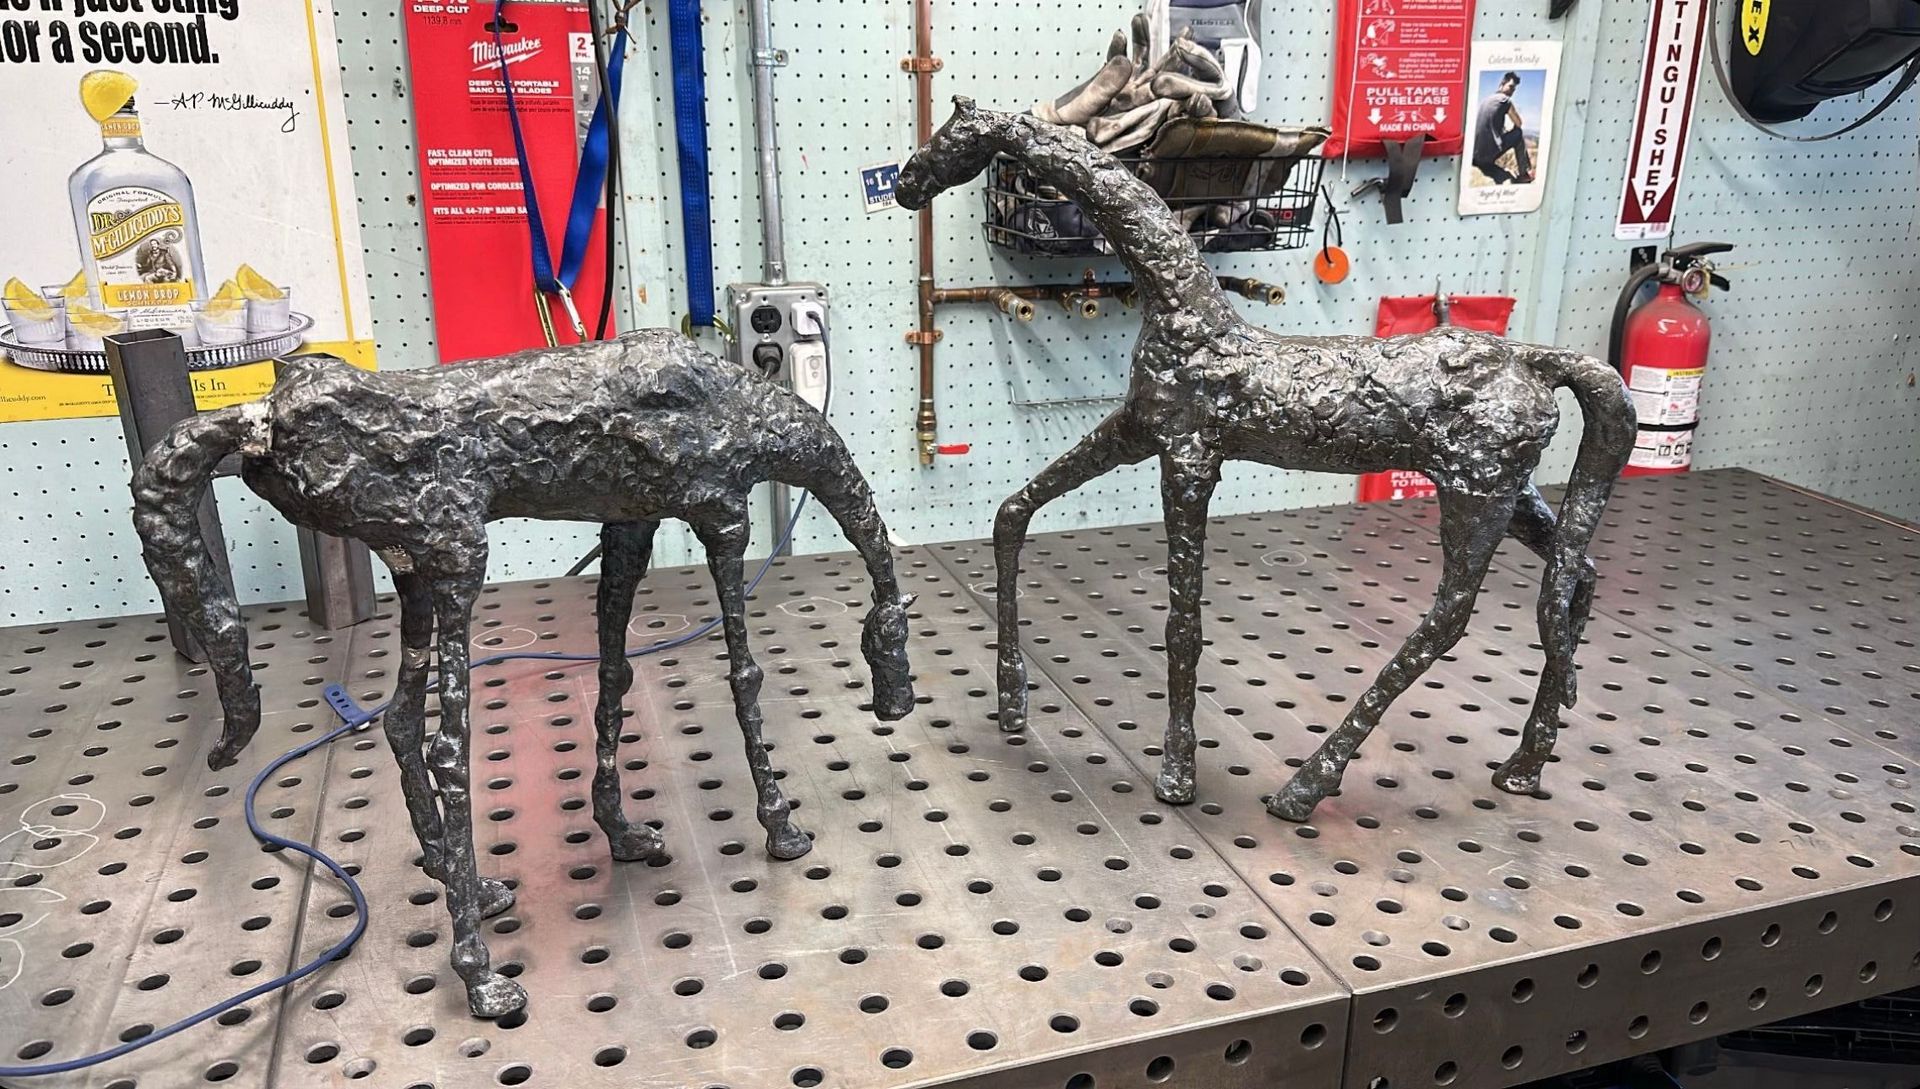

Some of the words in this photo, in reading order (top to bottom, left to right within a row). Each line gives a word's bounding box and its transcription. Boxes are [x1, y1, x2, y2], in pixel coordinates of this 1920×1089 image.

[413, 5, 444, 13] DEEP
[447, 5, 470, 13] CUT
[0, 20, 40, 62] or
[49, 20, 74, 63] a
[79, 14, 219, 64] second.
[577, 37, 586, 50] 2
[468, 36, 542, 64] Milwaukee
[575, 66, 592, 75] 14
[514, 80, 559, 88] PORTABLE
[517, 87, 552, 95] BLADES
[1367, 87, 1401, 97] PULL
[1405, 87, 1448, 96] TAPES
[1366, 97, 1386, 106] TO
[1390, 96, 1449, 105] RELEASE
[1642, 1, 1688, 206] TINGUISHER
[1380, 124, 1401, 132] MADE
[1412, 123, 1435, 131] CHINA
[427, 149, 447, 158] FAST,
[448, 149, 472, 157] CLEAN
[428, 158, 467, 166] OPTIMIZED
[469, 158, 492, 166] TOOTH
[875, 170, 891, 190] L
[890, 172, 898, 180] 17
[487, 182, 525, 190] CORDLESS
[97, 190, 130, 204] ORIGINAL
[496, 207, 516, 215] BAND
[117, 290, 149, 301] LEMON
[154, 289, 179, 301] DROP
[193, 379, 206, 392] Is
[210, 377, 226, 391] In
[1391, 479, 1409, 487] TO
